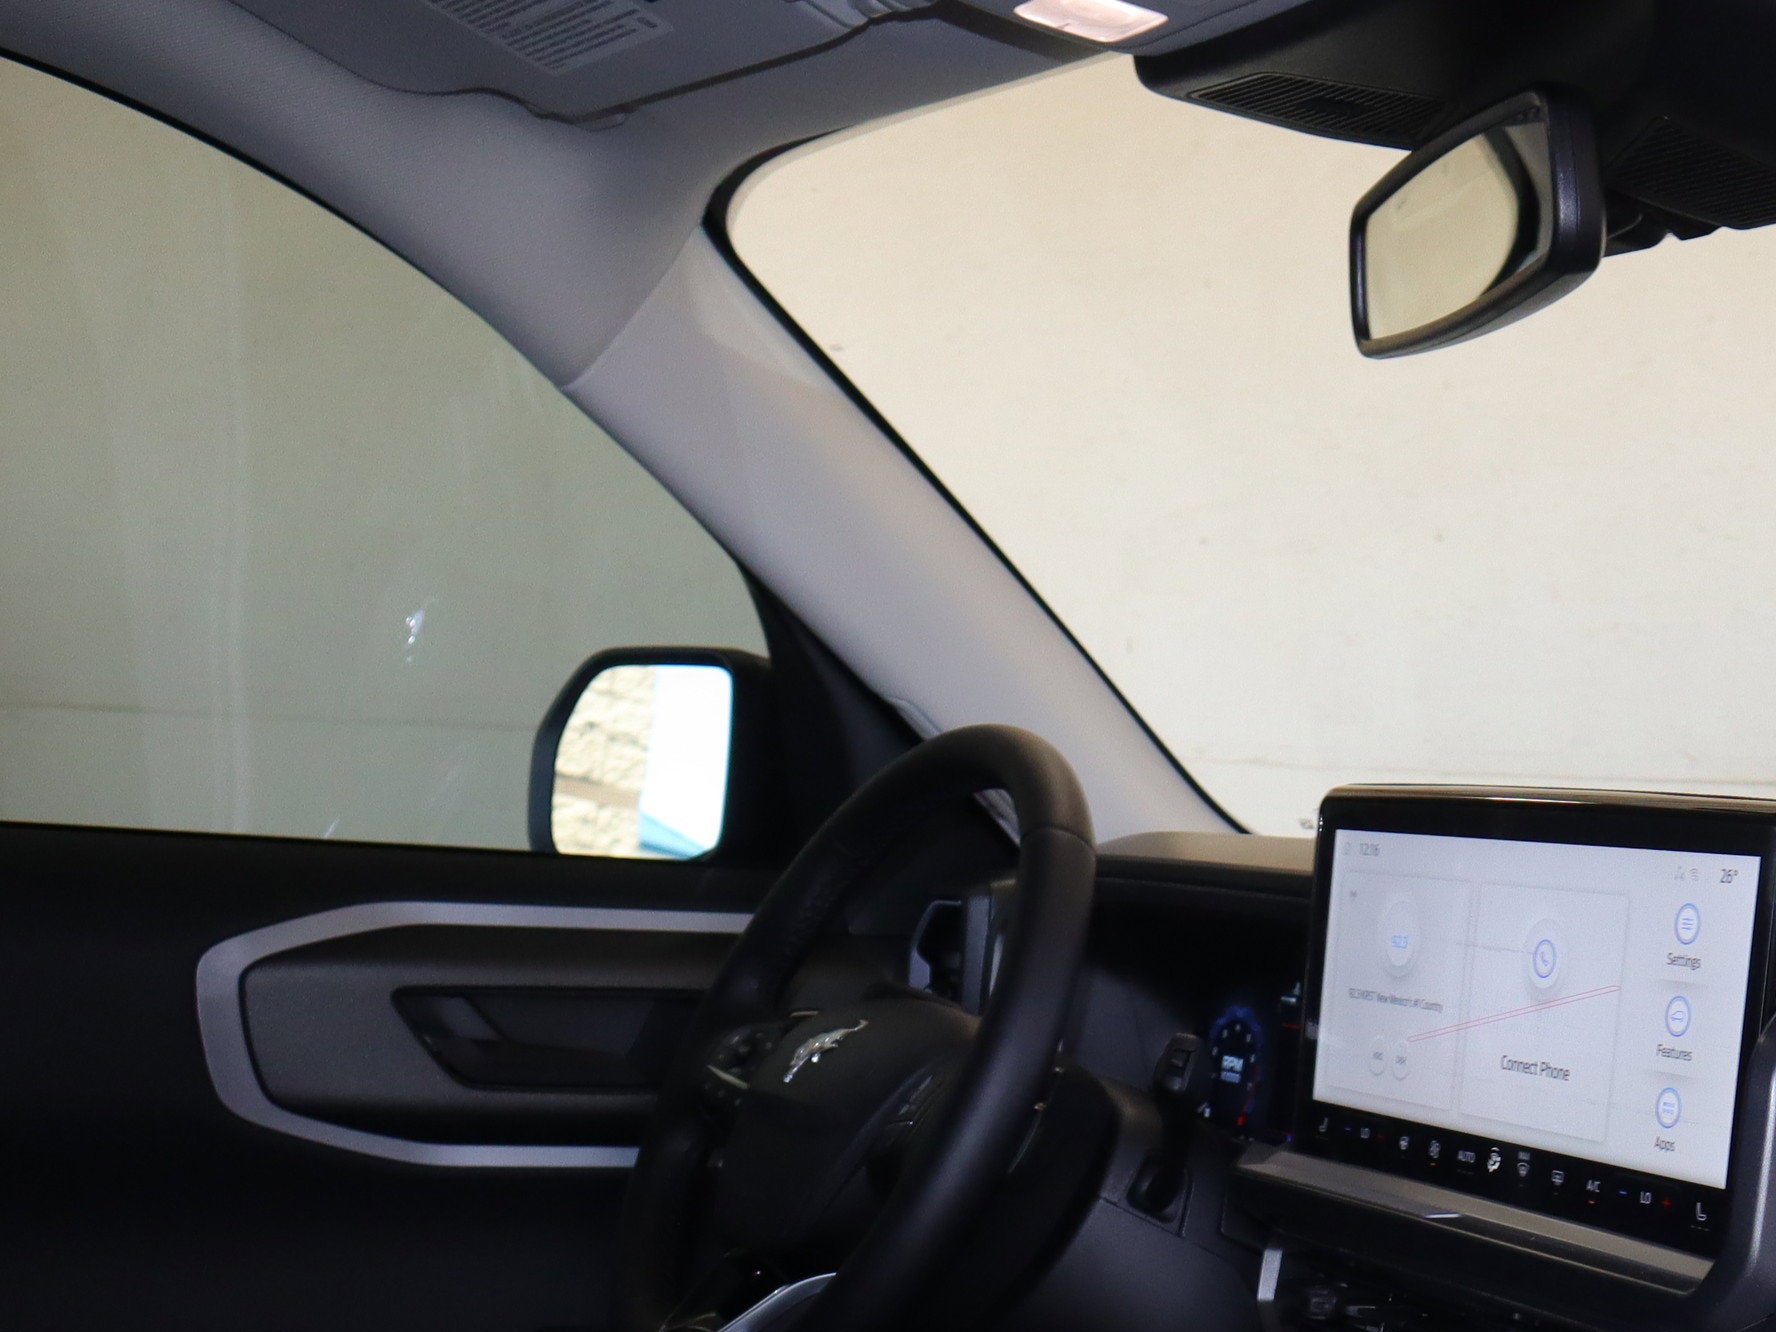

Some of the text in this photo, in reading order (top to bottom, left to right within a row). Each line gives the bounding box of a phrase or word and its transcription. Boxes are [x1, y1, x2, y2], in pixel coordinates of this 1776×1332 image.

[1666, 952, 1702, 971] Settings
[1656, 1043, 1693, 1062] Features
[1501, 1055, 1570, 1082] Connect Phone
[1654, 1136, 1676, 1153] Apps
